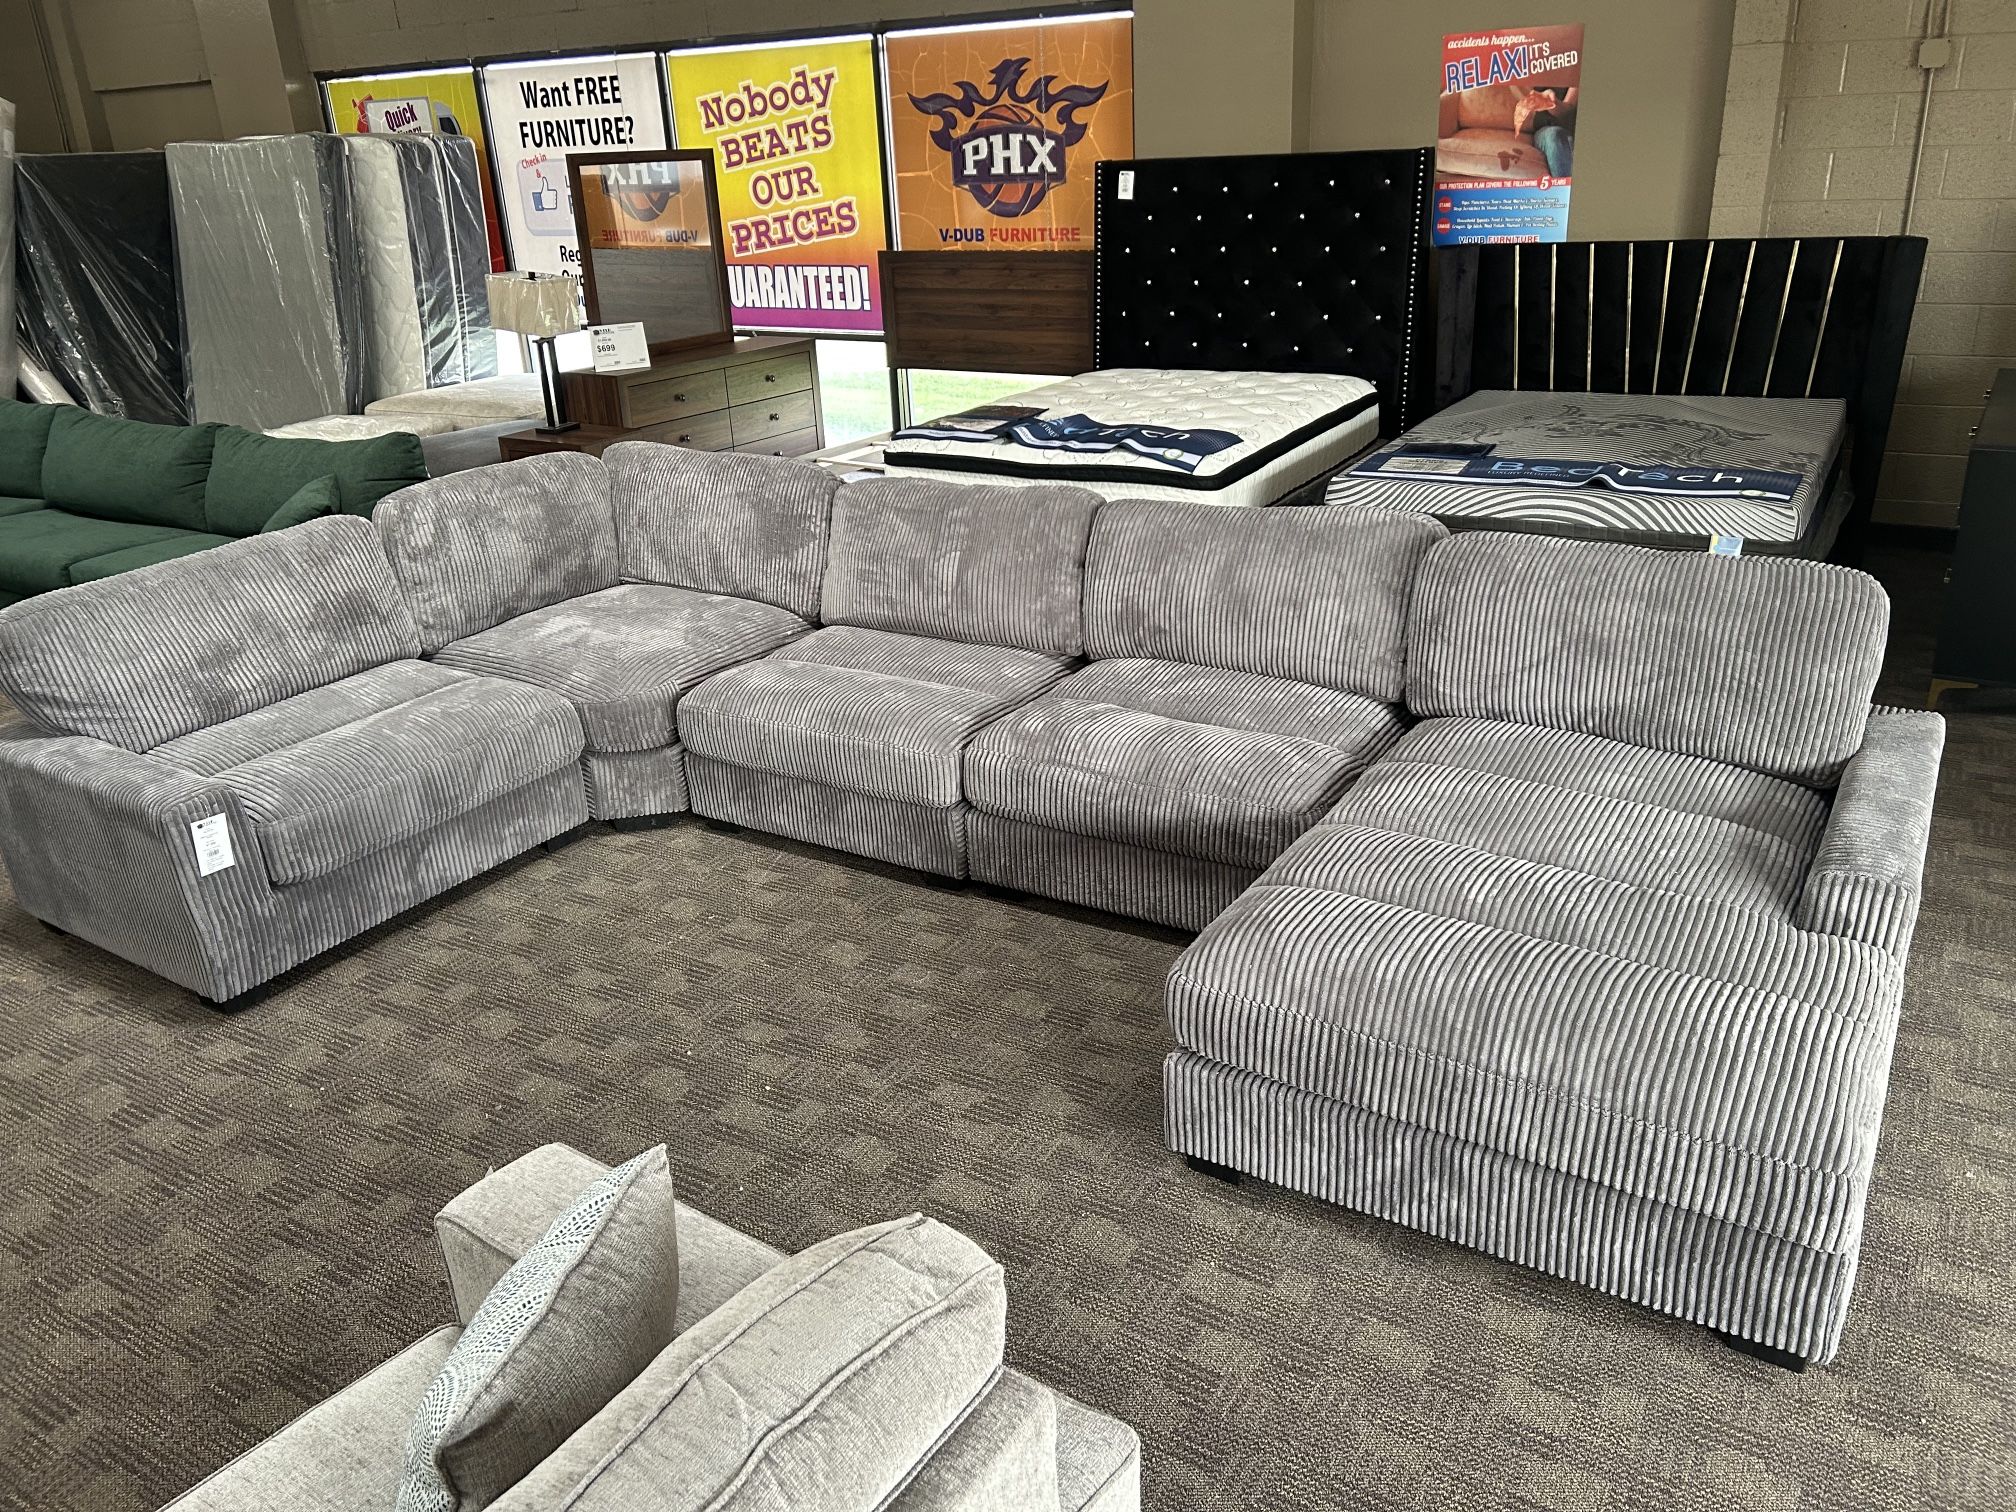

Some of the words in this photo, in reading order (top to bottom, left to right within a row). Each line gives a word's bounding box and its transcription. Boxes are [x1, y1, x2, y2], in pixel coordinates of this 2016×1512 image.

[1448, 36, 1489, 49] accidents
[1491, 34, 1535, 48] happen...
[1529, 42, 1550, 60] IT'S
[1445, 45, 1529, 94] RELAX!
[1530, 51, 1578, 74] COVERED
[519, 80, 571, 109] Want
[573, 75, 622, 105] FREE
[698, 68, 836, 131] Nobody
[385, 102, 418, 132] Quick
[518, 115, 634, 148] FURNITURE?
[719, 113, 833, 170] BEATS
[961, 132, 1058, 176] PHX
[521, 155, 540, 169] Check
[540, 153, 547, 163] in
[536, 168, 541, 178] &
[751, 165, 820, 206] OUR
[1540, 176, 1550, 189] 5
[1551, 178, 1566, 186] YEARS
[730, 200, 858, 255] PRICES
[939, 228, 985, 242] V-DUB
[989, 227, 1081, 242] FURNITURE
[1487, 235, 1540, 243] FURNITURE
[727, 264, 872, 311] UARANTEED!
[597, 344, 616, 353] $699
[1490, 457, 1744, 485] BedTech
